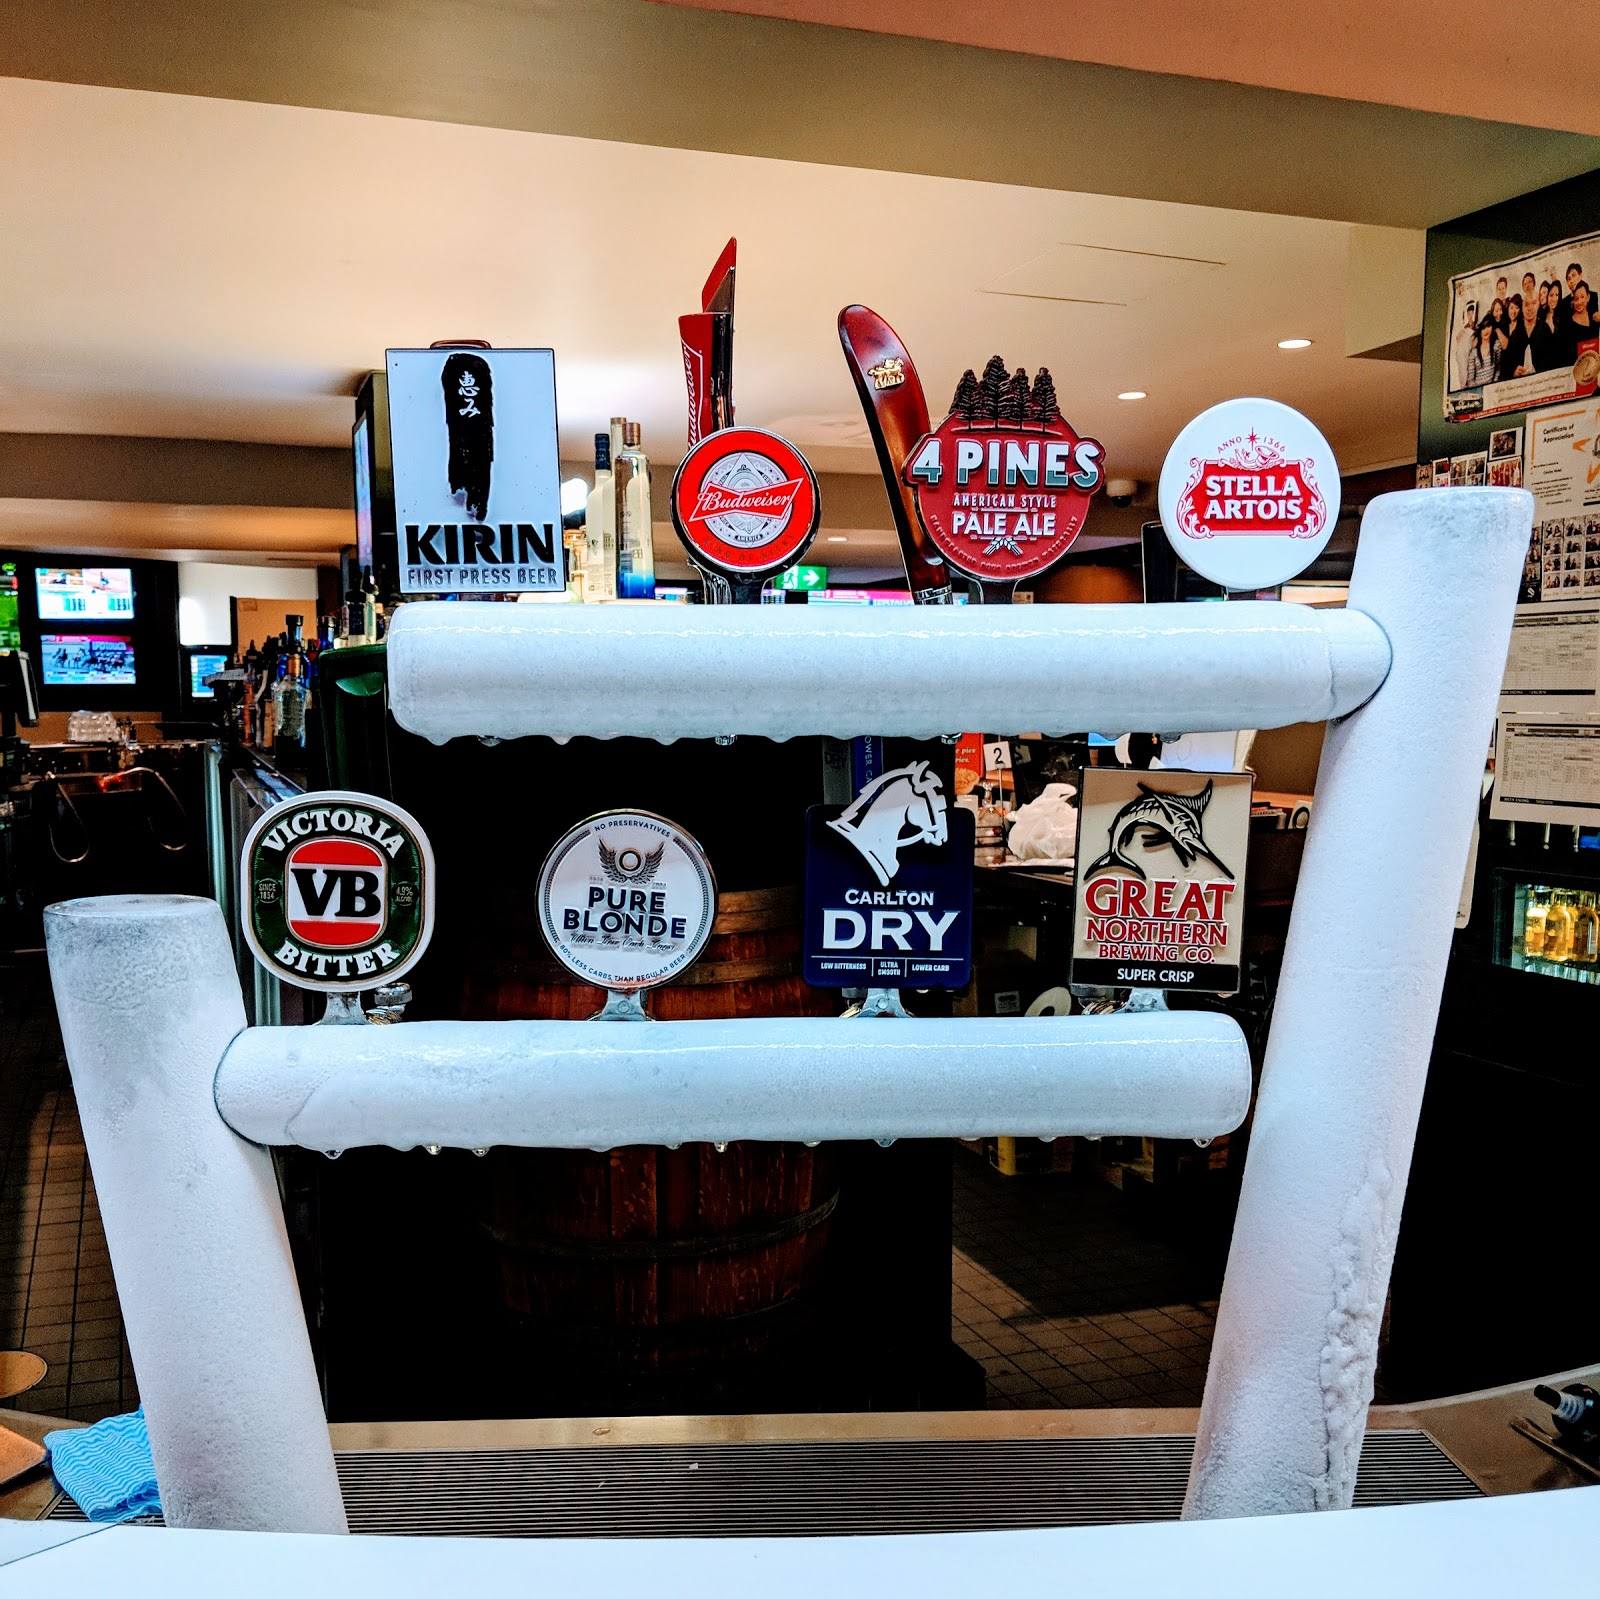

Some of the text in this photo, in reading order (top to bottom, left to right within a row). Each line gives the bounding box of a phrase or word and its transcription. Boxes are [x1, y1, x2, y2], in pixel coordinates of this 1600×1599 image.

[458, 370, 481, 418] 恵み
[1542, 426, 1567, 435] Certificate
[1543, 433, 1575, 443] Appreciation
[1217, 436, 1286, 454] ANNO 1366
[912, 438, 1102, 488] 4 PINES
[1205, 475, 1301, 497] STELLA
[697, 491, 792, 511] Budweiser
[953, 493, 1057, 509] AMERICAN STYLE
[1204, 499, 1302, 520] ARTOIS
[952, 511, 1057, 536] PALE ALE
[405, 524, 555, 565] KIRIN
[407, 568, 558, 587] FIRST PRESS BEER
[864, 735, 873, 766] OWER
[993, 747, 1004, 764] 2
[261, 810, 405, 858] VICTORIA
[594, 820, 671, 838] NO PRESERVATIVES
[259, 883, 276, 891] SINCE
[260, 891, 275, 900] 1854
[291, 869, 381, 917] VB
[588, 886, 666, 914] PURE
[845, 889, 934, 906] CARLTON
[1085, 877, 1235, 921] GREAT
[563, 908, 687, 939] BLONDE
[822, 908, 961, 951] DRY
[1085, 918, 1229, 946] NORTHERN
[274, 940, 401, 977] BITTER
[559, 944, 572, 958] 80%
[571, 956, 587, 971] LESS
[588, 968, 612, 980] CARBS
[636, 966, 669, 982] REGULAR
[669, 953, 686, 969] BEER
[1098, 943, 1215, 963] BREWING CO.
[820, 962, 833, 970] LOW
[877, 968, 901, 976] SMOOTH
[933, 964, 950, 972] CARB
[1117, 968, 1195, 983] SUPER CRISP
